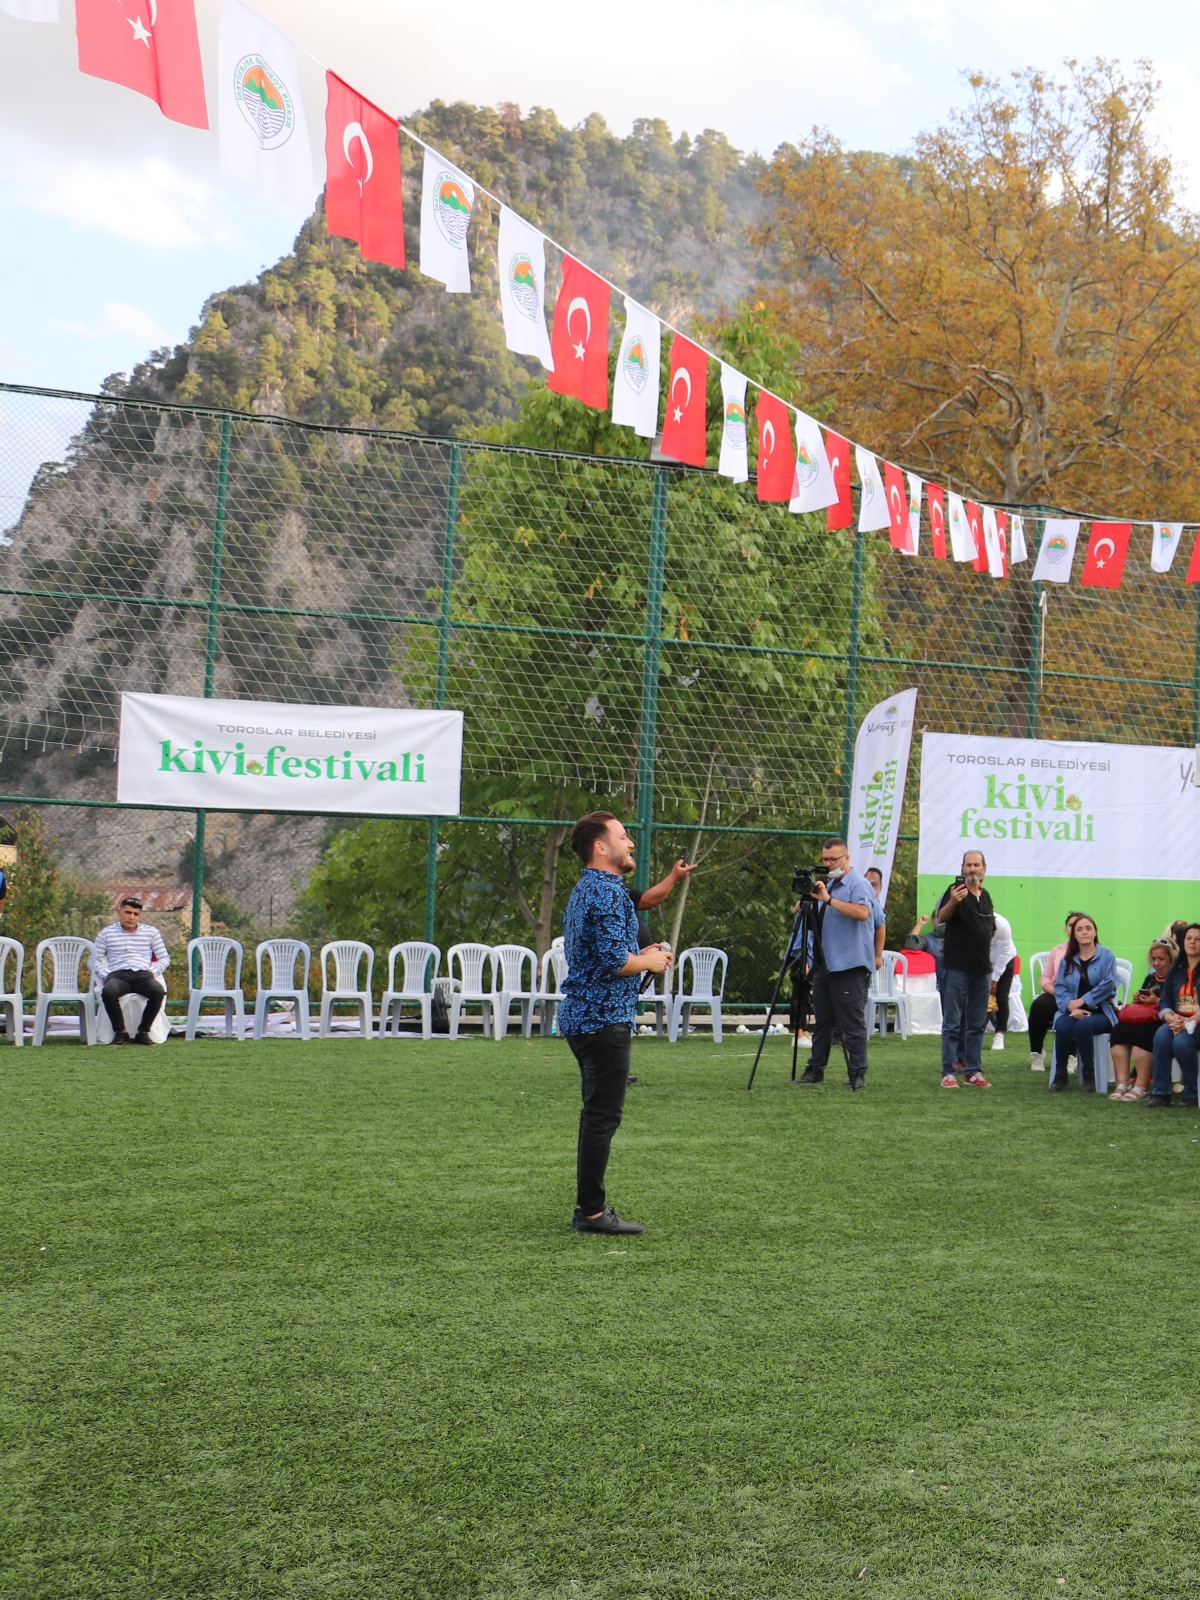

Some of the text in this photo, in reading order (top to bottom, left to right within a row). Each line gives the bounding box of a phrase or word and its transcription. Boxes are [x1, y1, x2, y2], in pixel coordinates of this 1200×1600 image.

[216, 724, 377, 741] TOROSLAR BELEDİYESİ
[157, 739, 427, 783] kivi festivali
[947, 753, 1111, 771] TOROSLAR BELEDİYESİ
[873, 759, 898, 856] festivali
[983, 773, 1067, 811] kivi
[858, 783, 883, 842] kivi
[958, 807, 1096, 842] festivali
